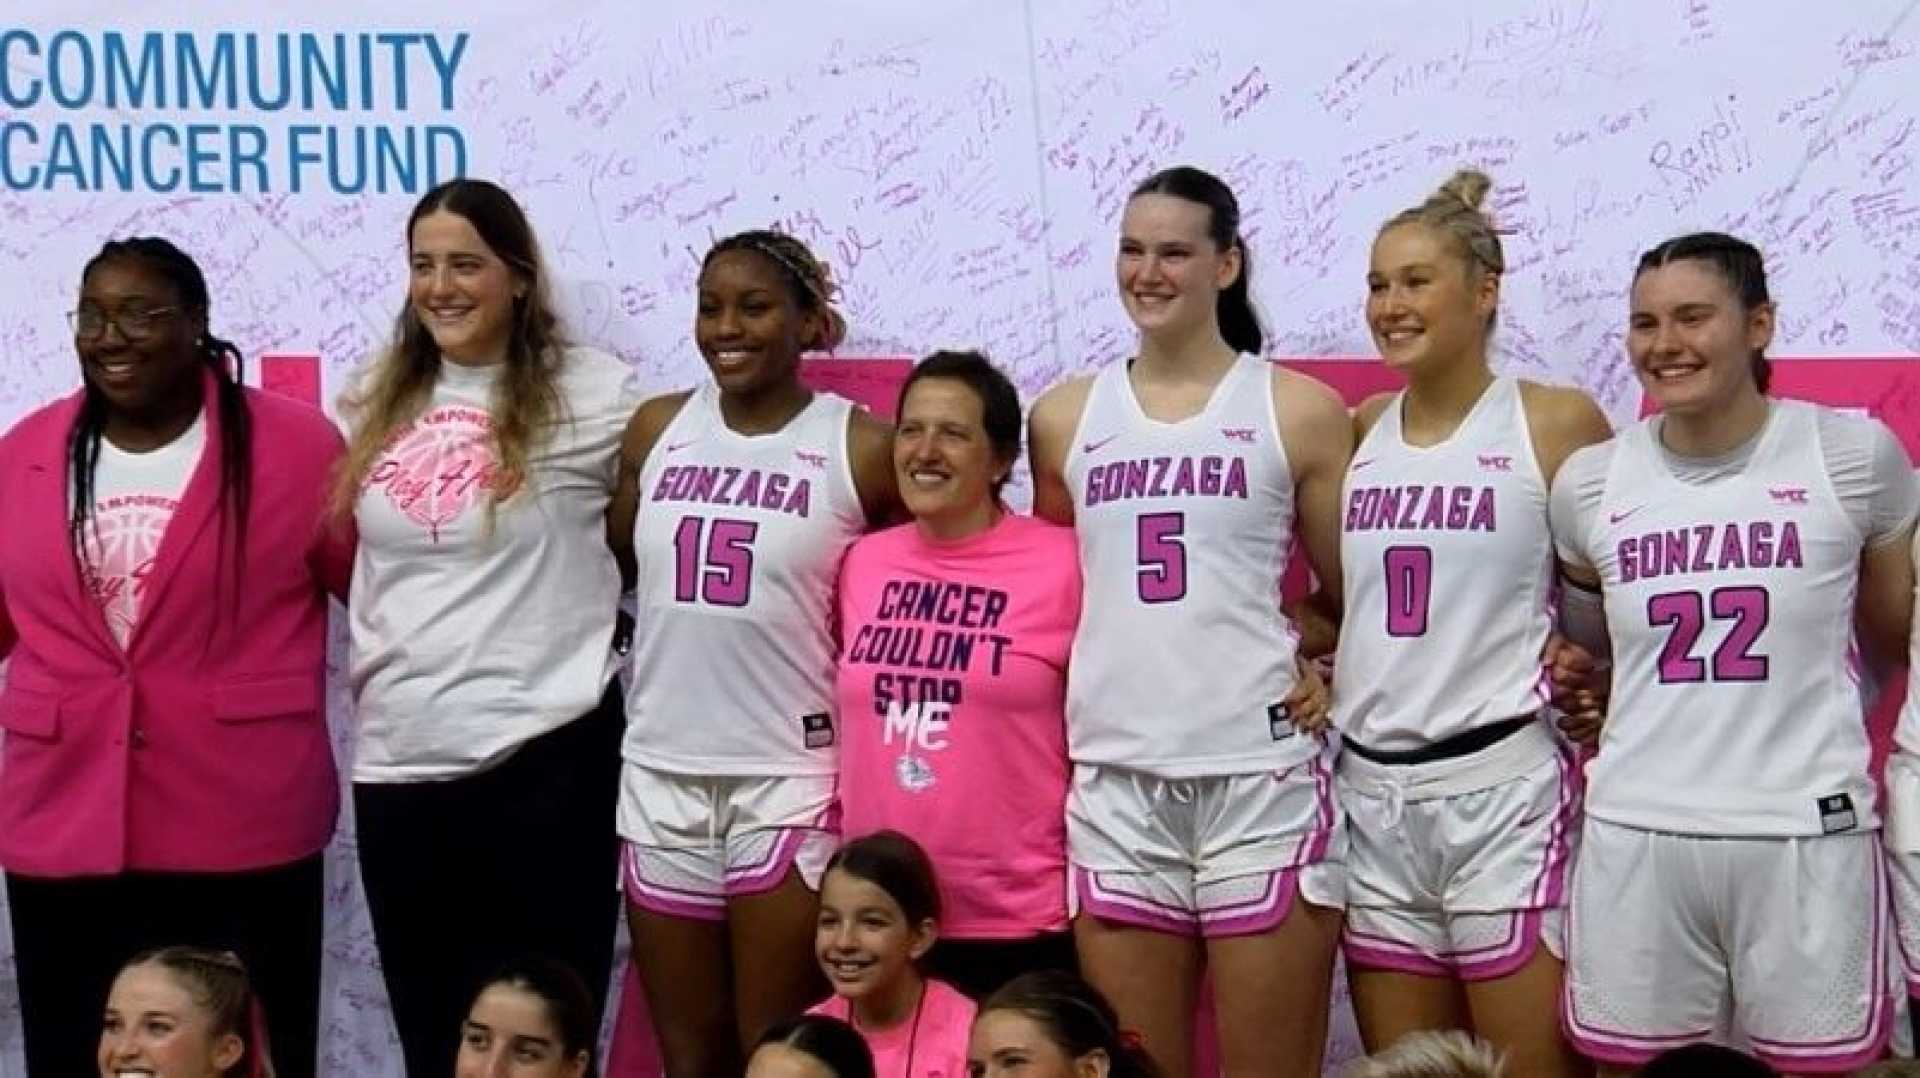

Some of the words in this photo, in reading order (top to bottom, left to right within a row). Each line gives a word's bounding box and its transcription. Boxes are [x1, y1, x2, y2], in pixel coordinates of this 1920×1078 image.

[0, 30, 469, 110] COMMUNITY
[0, 122, 270, 193] CANCER
[288, 125, 469, 195] FUND
[651, 465, 811, 518] GONZAGA
[1085, 455, 1248, 506] GONZAGA
[1345, 486, 1497, 532] GONZAGA
[673, 515, 759, 607] 15
[1136, 512, 1188, 604] 5
[1617, 521, 1804, 583] GONZAGA
[877, 581, 1008, 628] CANCER
[1383, 546, 1432, 637] 0
[848, 625, 1013, 676] COULDN'T
[1646, 586, 1770, 684] 22
[874, 673, 962, 716] STOP
[883, 701, 954, 751] ME
